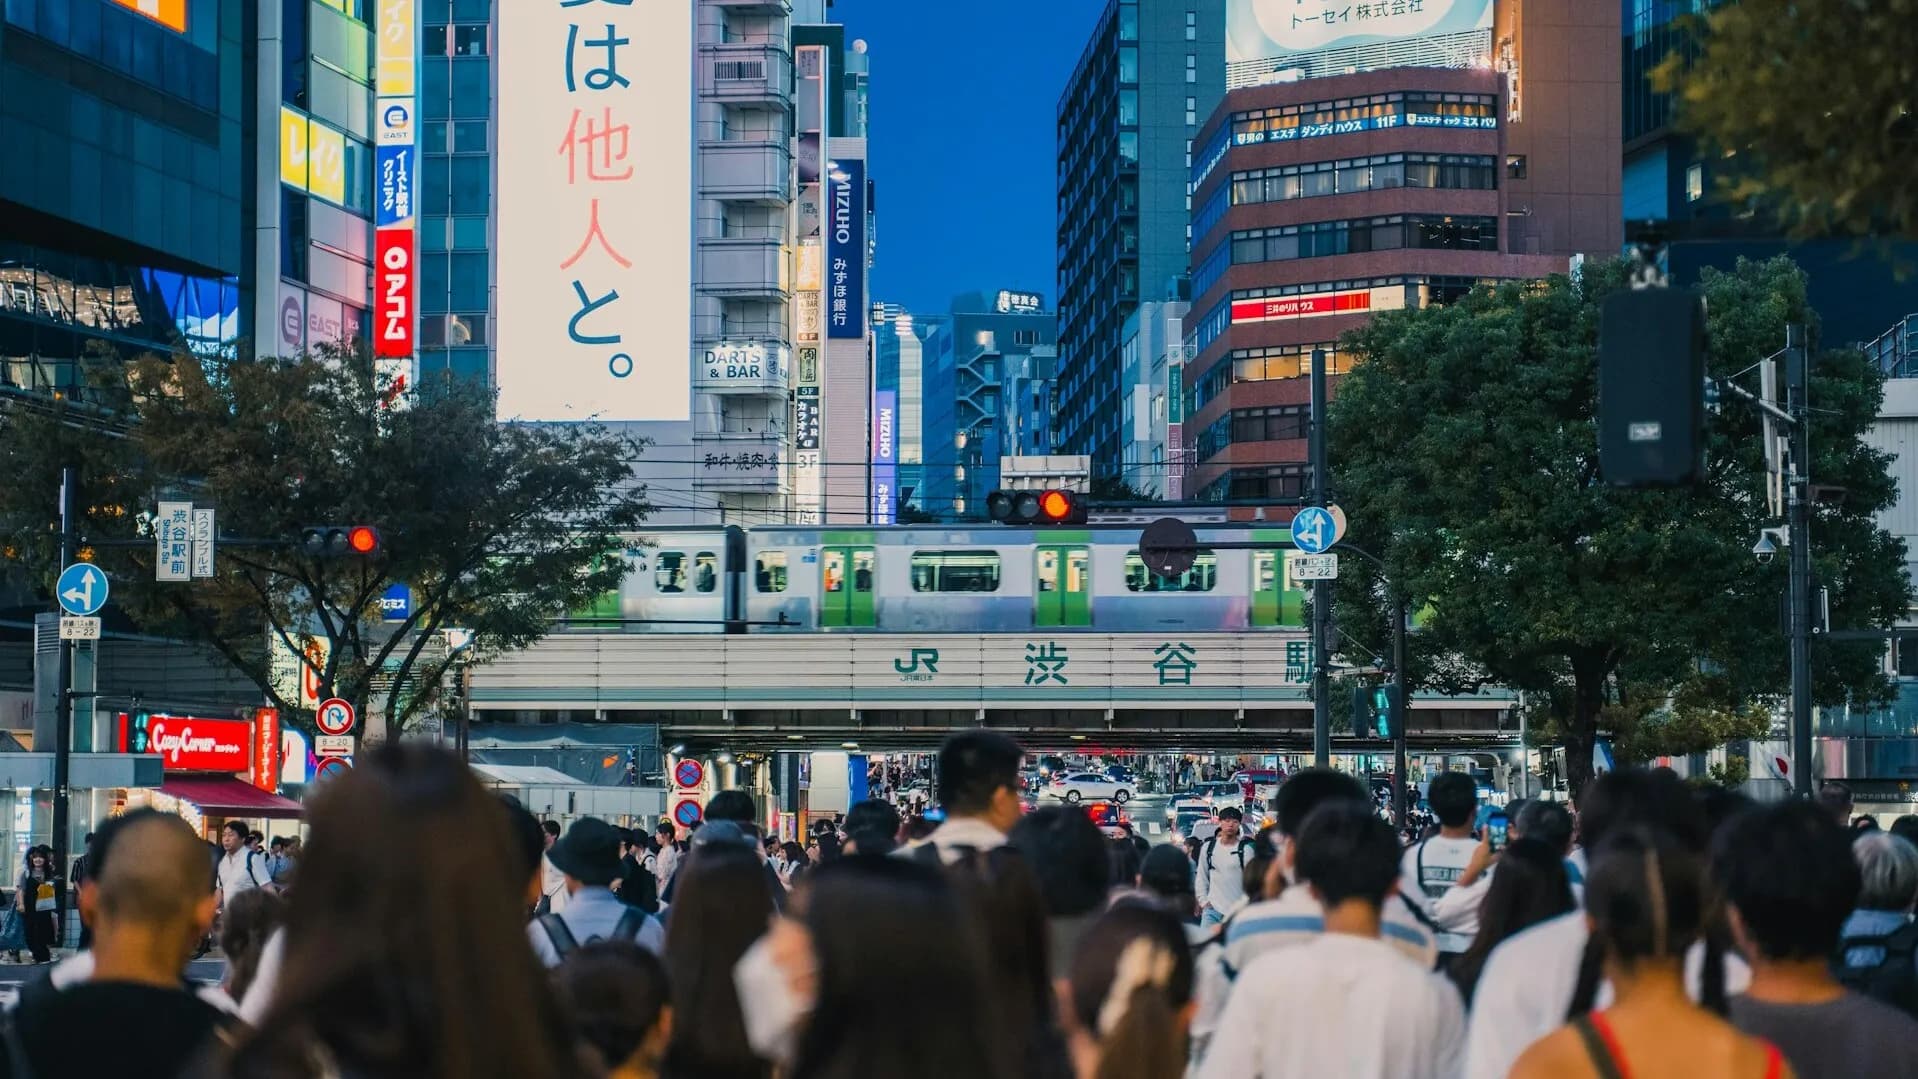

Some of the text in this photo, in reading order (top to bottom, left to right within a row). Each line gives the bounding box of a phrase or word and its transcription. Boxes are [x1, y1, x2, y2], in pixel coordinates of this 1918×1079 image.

[1291, 0, 1424, 30] トーセイ株式会社
[1376, 115, 1398, 129] 11F
[383, 159, 395, 212] クリニック
[558, 0, 634, 378] は他人と。
[835, 173, 852, 245] MIZUHO
[833, 257, 848, 326] みずほ銀行
[1265, 300, 1315, 315] 三井のリハウス
[309, 313, 340, 337] EAST
[704, 350, 761, 364] DARTS
[710, 365, 761, 378] & BAR
[802, 387, 815, 396] 5F
[798, 401, 808, 441] カラオケ
[880, 408, 892, 458] MIZUHO
[799, 454, 817, 469] 3F
[172, 508, 187, 575] 渋谷駅前
[198, 512, 209, 574] スクランブル式
[894, 648, 939, 673] JR
